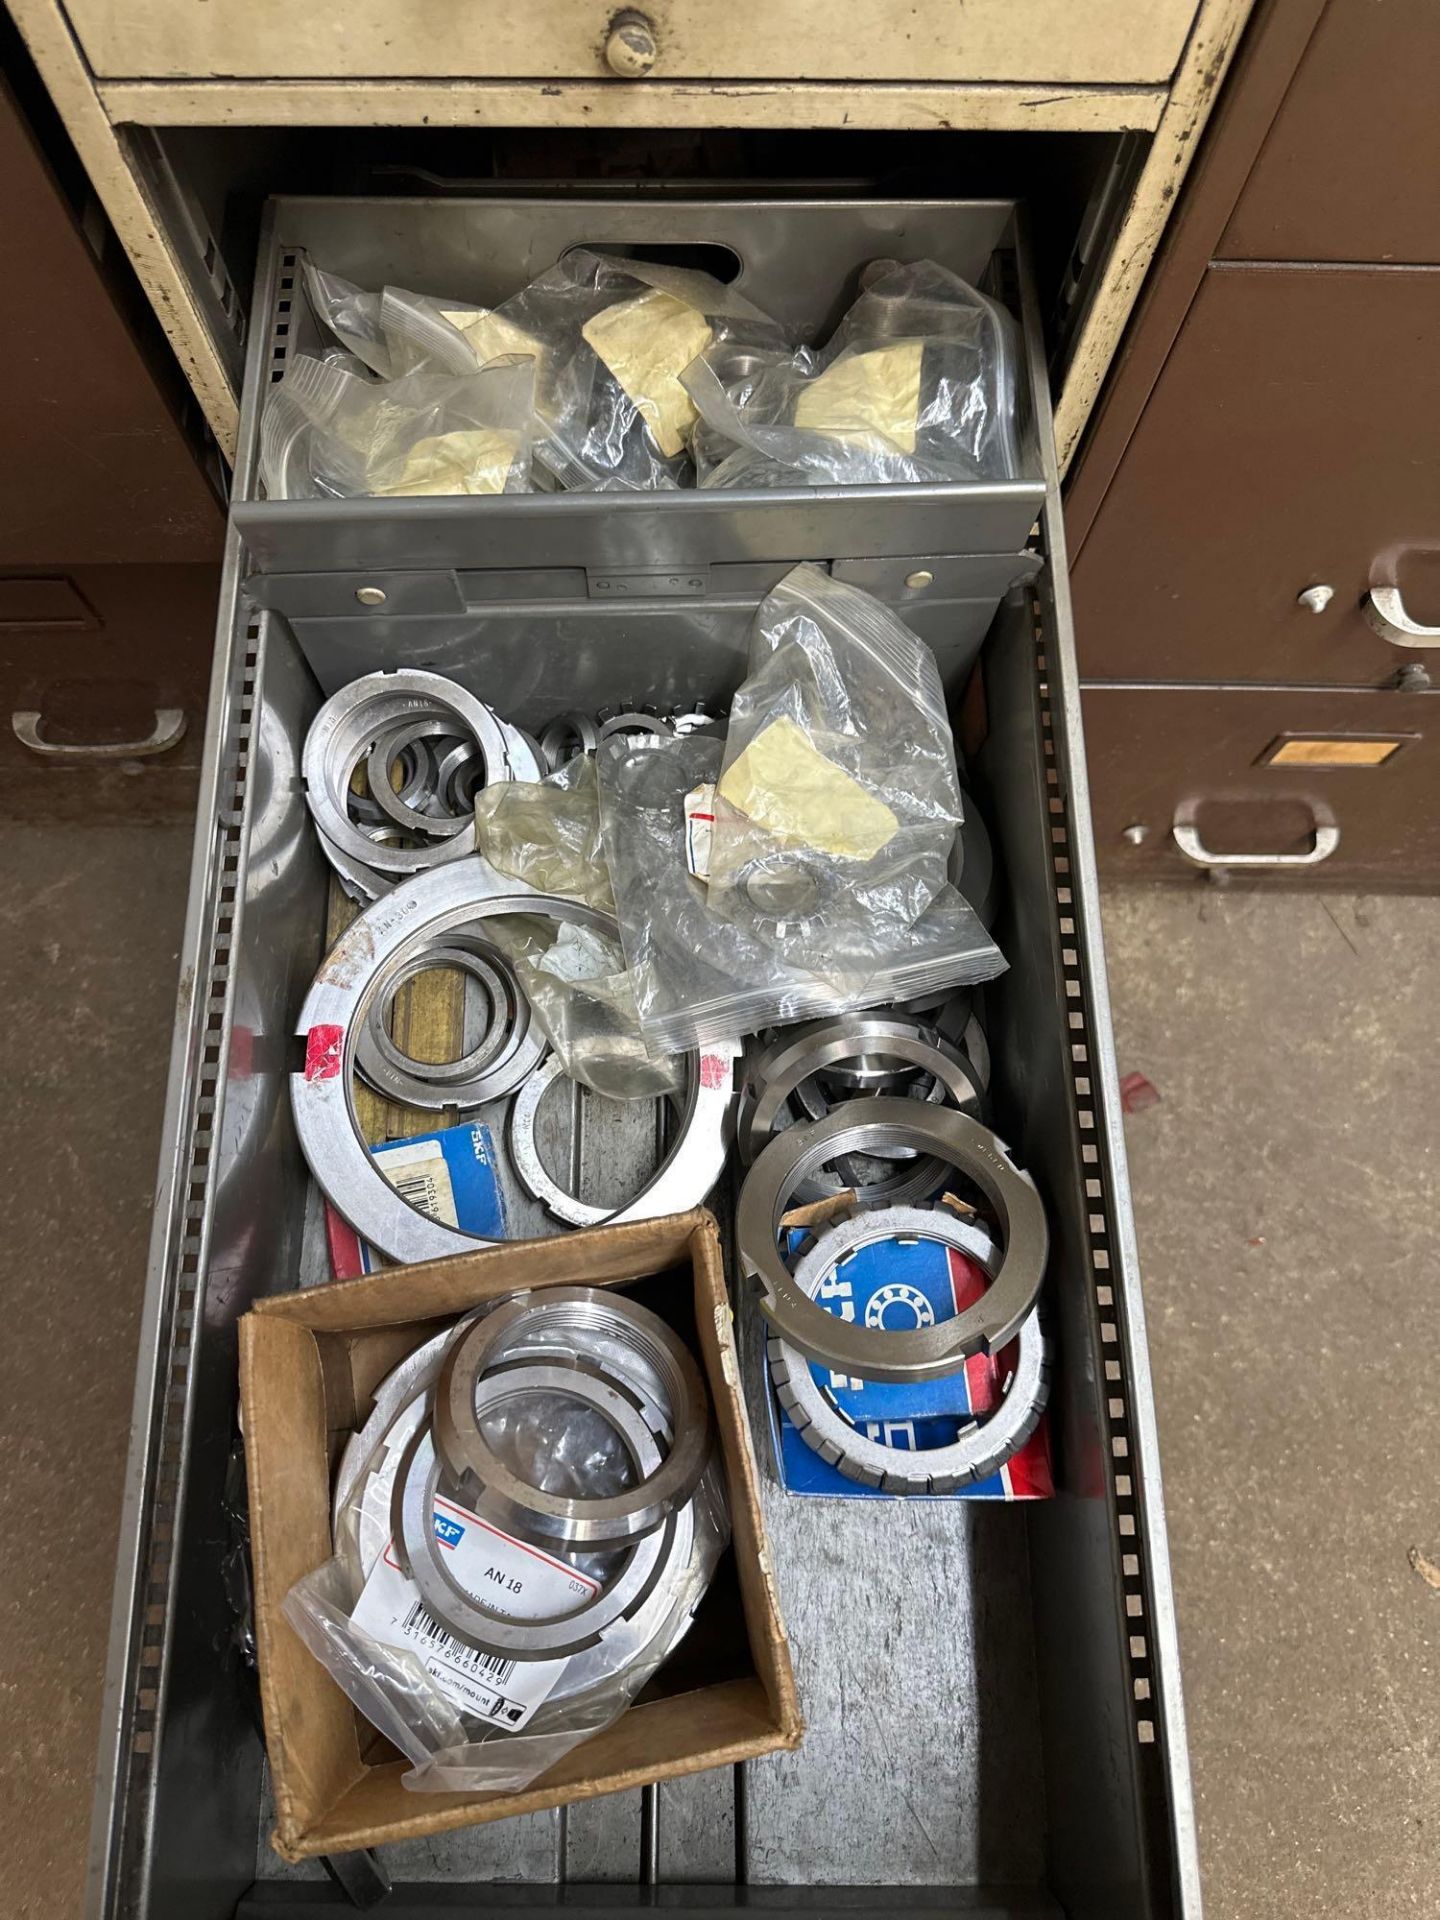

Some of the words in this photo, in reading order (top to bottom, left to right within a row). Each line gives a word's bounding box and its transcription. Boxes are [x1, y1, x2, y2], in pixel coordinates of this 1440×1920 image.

[470, 1130, 487, 1166] SKF
[426, 1177, 440, 1213] 619304
[434, 1518, 461, 1538] KF
[484, 1567, 506, 1585] AN
[506, 1579, 523, 1594] 18
[568, 1580, 588, 1597] 037X
